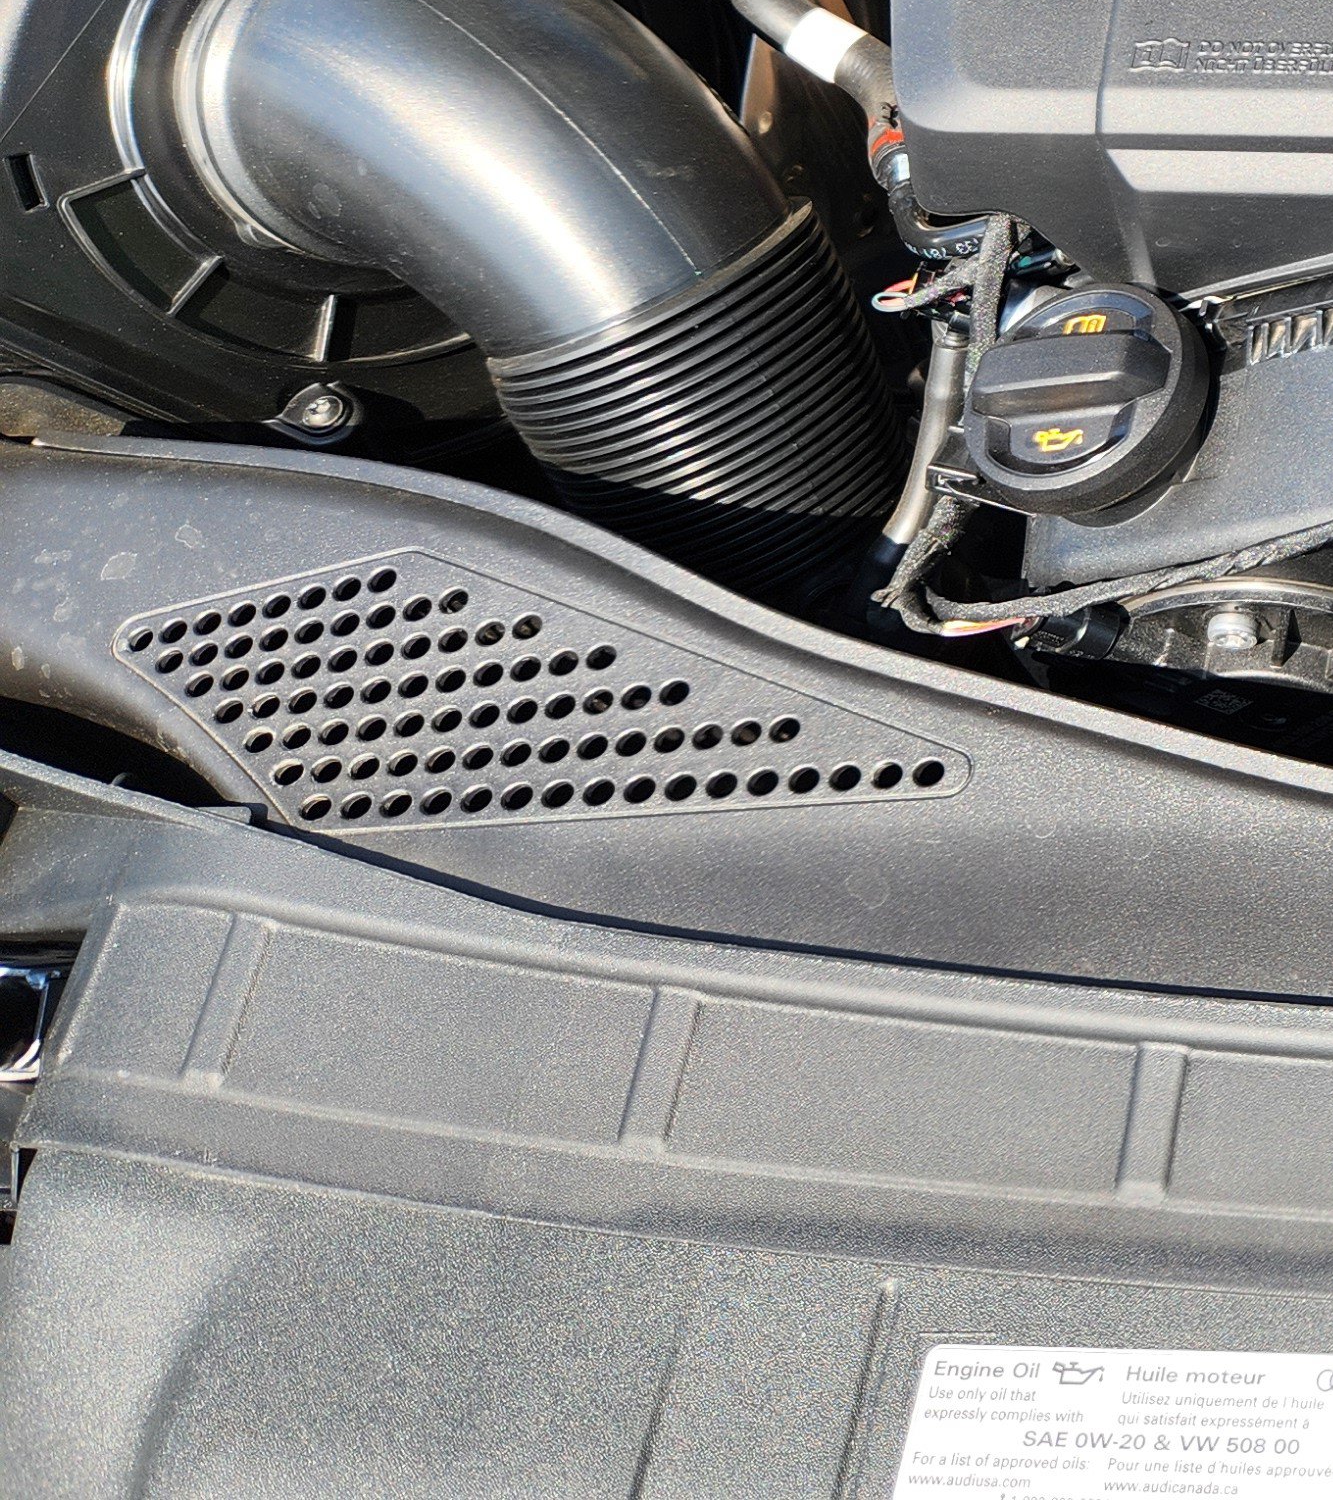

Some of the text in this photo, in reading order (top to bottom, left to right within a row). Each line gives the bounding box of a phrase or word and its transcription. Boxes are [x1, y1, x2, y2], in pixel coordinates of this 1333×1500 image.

[1199, 41, 1225, 56] DO
[1227, 41, 1264, 57] NOT
[1193, 58, 1249, 74] NICHT
[934, 1360, 1041, 1380] Engine Oil
[1126, 1366, 1266, 1385] Huile moteur
[929, 1386, 1036, 1401] Use only oil that
[1121, 1391, 1171, 1405] Utilisez
[1175, 1393, 1258, 1409] uniquement
[1262, 1396, 1279, 1408] de
[924, 1407, 1084, 1423] expressly complies with
[1118, 1412, 1139, 1426] qui
[1143, 1412, 1196, 1426] satisfait
[1201, 1416, 1298, 1429] expressément
[1023, 1430, 1300, 1454] SAE 0W-20 & VW 508 00
[913, 1451, 1091, 1470] For a list of approved oils:
[1107, 1457, 1140, 1471] Pour
[1145, 1462, 1169, 1472] une
[1174, 1460, 1203, 1473] liste
[908, 1474, 1031, 1488] www.audiusa.com
[1104, 1480, 1238, 1495] www.audicanada.ca
